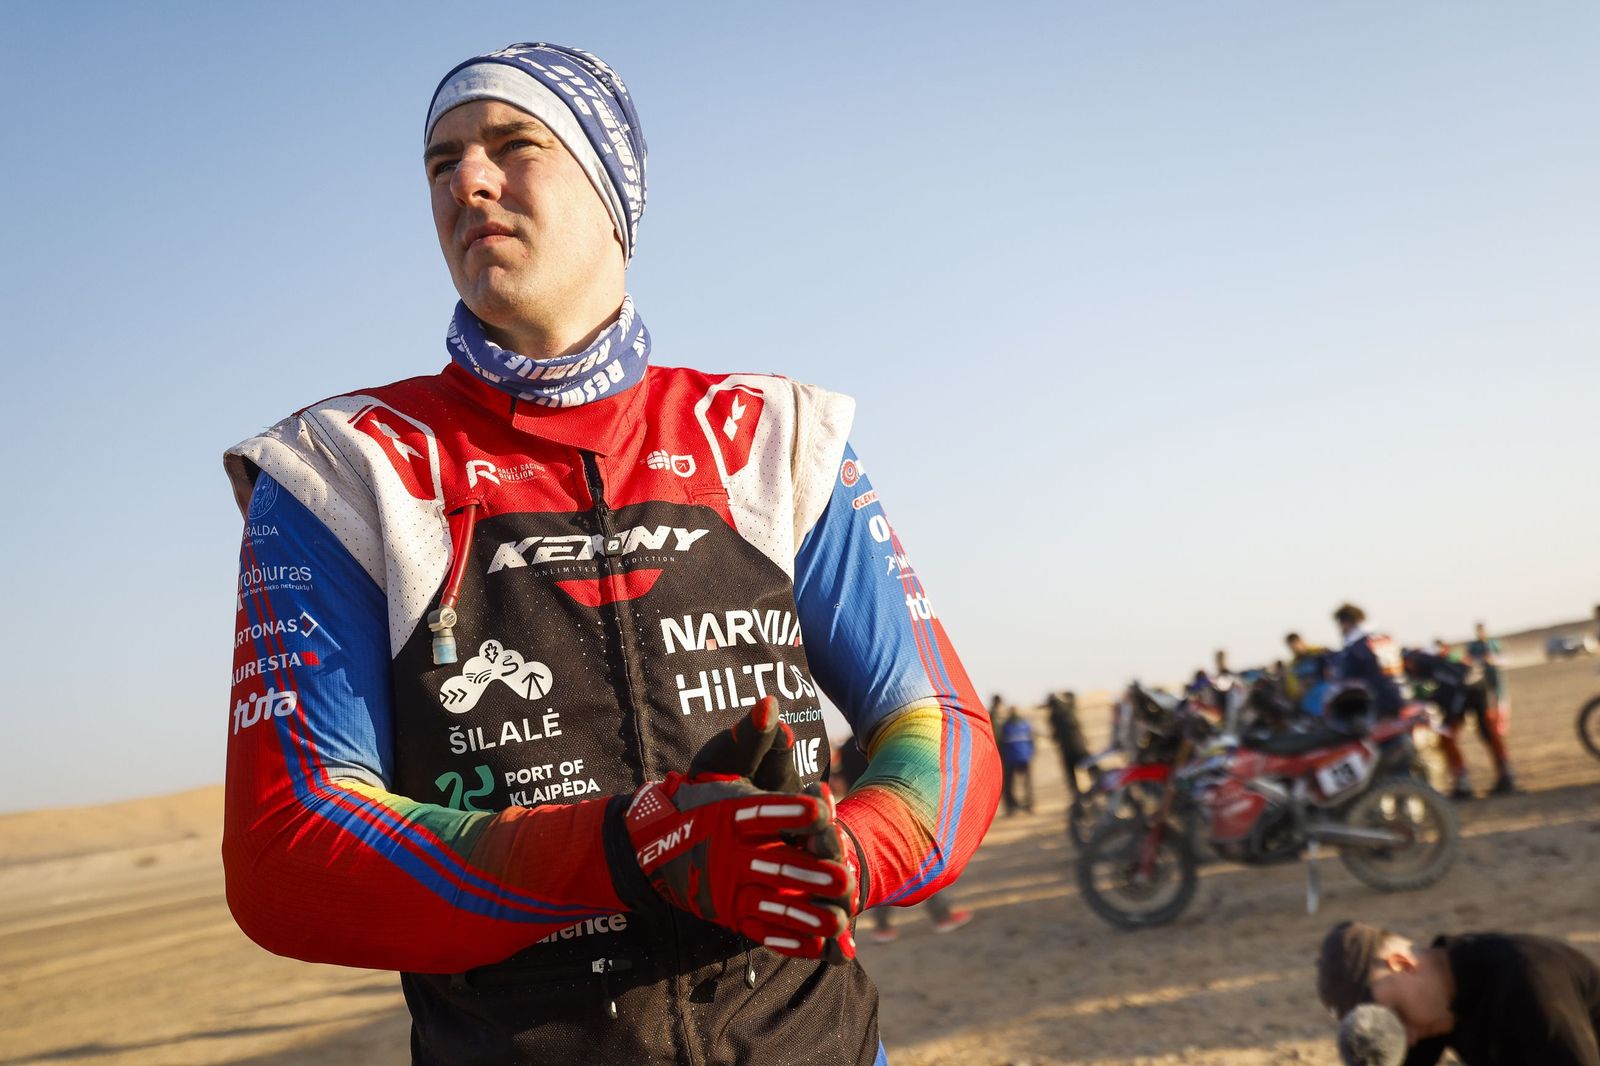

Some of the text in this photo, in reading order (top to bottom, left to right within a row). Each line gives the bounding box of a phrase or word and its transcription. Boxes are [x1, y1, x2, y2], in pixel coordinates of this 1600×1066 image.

[499, 470, 534, 481] DIVISION
[487, 525, 710, 575] KENNY
[241, 562, 312, 590] robiuras
[533, 566, 598, 578] UNLIMITED
[234, 619, 298, 649] RTONAS
[449, 708, 562, 755] ŠILALĖ
[505, 759, 584, 787] PORT OF
[509, 777, 601, 807] KLAIPĖDA
[637, 817, 694, 867] ENNY
